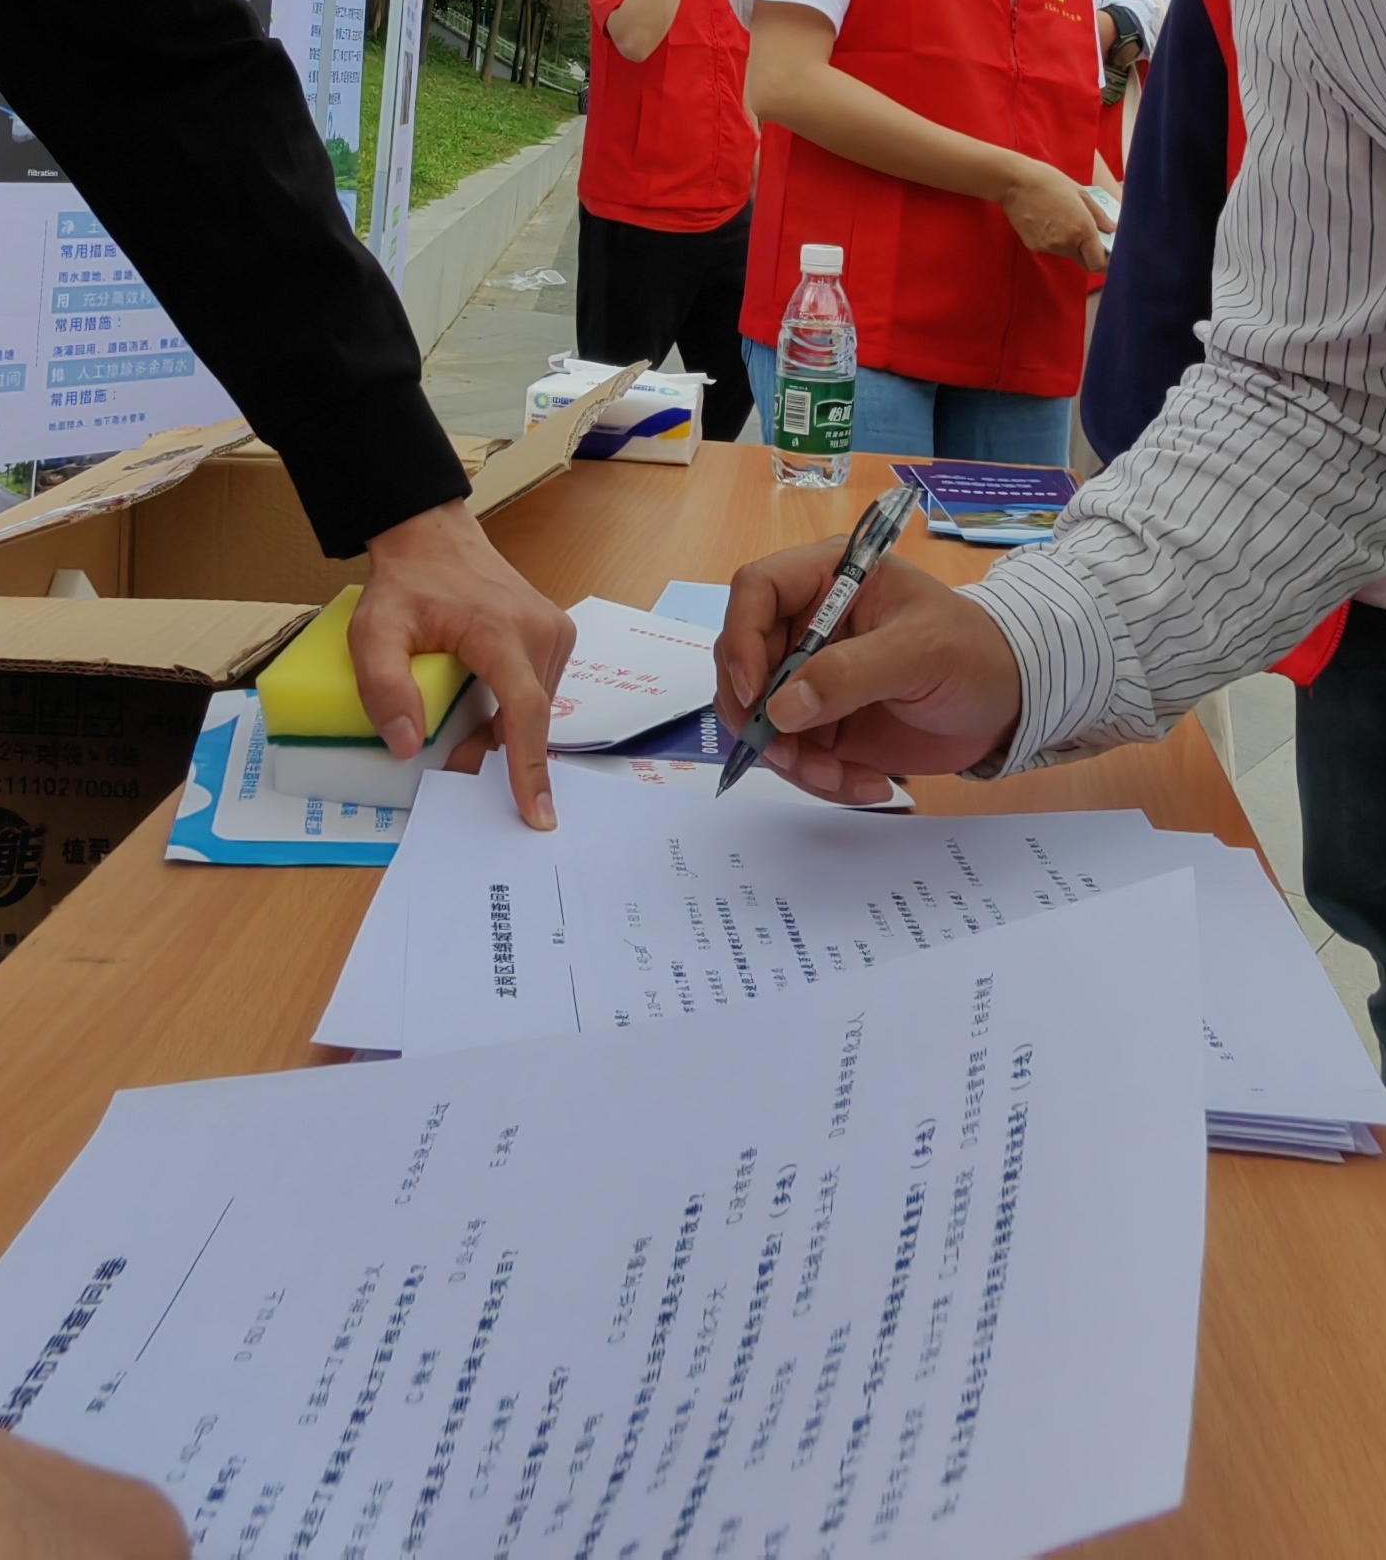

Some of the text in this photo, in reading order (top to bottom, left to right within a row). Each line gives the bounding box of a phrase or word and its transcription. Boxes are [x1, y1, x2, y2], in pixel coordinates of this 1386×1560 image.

[82, 290, 157, 307] 充分高效利
[489, 884, 517, 998] 龙岗区海绵城市调查问卷
[289, 1265, 426, 1560] 途径了解城市建设方面相关信息？
[402, 1251, 518, 1560] 作环境是否有海绵城市建设项目？
[494, 1367, 568, 1560] 己的生活影响大吗？
